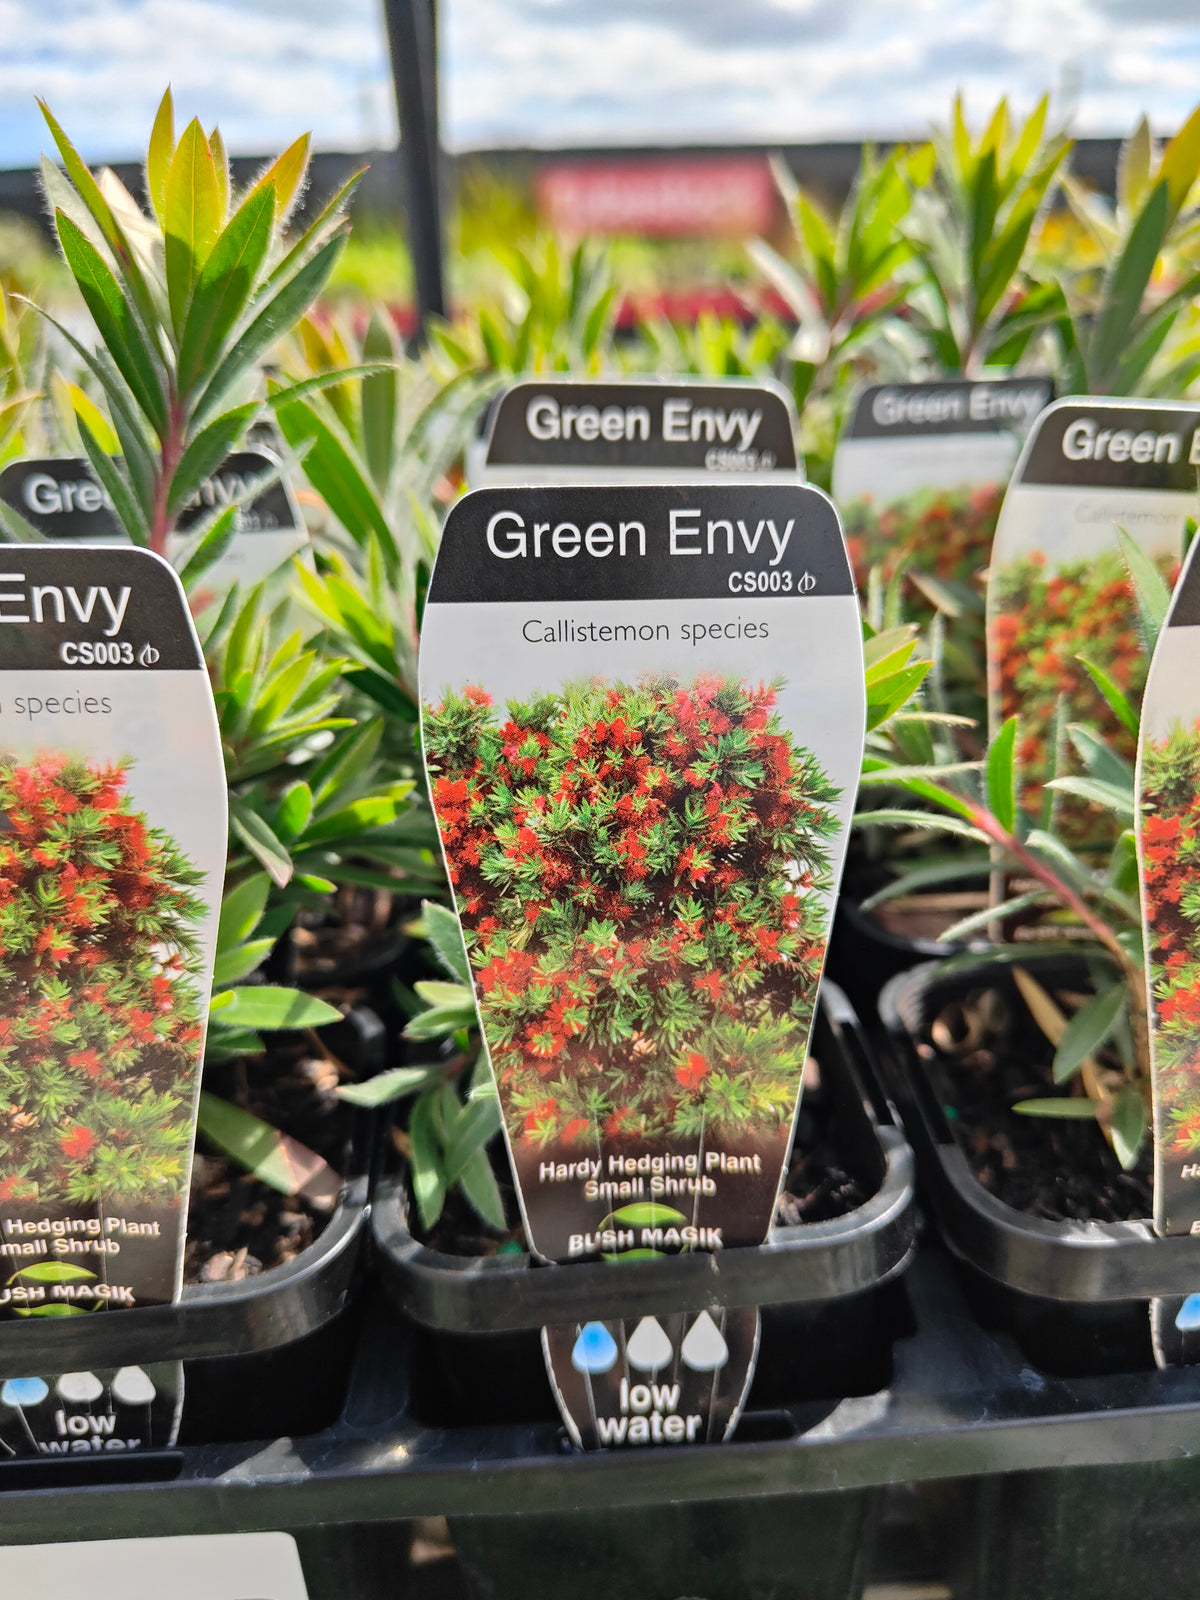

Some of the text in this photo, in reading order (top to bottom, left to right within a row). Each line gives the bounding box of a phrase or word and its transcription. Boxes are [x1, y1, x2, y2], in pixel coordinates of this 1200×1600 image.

[873, 386, 969, 425] Green
[526, 396, 763, 450] Green Envy
[1062, 418, 1183, 465] Green
[485, 510, 796, 566] Green Envy
[728, 571, 793, 593] CS003
[0, 573, 132, 637] Envy
[522, 616, 770, 646] Callistemon species
[59, 641, 135, 665] CS003
[14, 690, 113, 721] species
[539, 1151, 762, 1183] Hardy Hedging Plant
[584, 1174, 717, 1200] Small Shrub
[5, 1216, 161, 1237] Hedging Plant
[567, 1226, 723, 1254] BUSH MAGIK
[0, 1238, 121, 1256] mall Shrub
[50, 1283, 136, 1303] MAGIK
[619, 1377, 680, 1414] low
[55, 1409, 116, 1436] low
[597, 1411, 702, 1445] water
